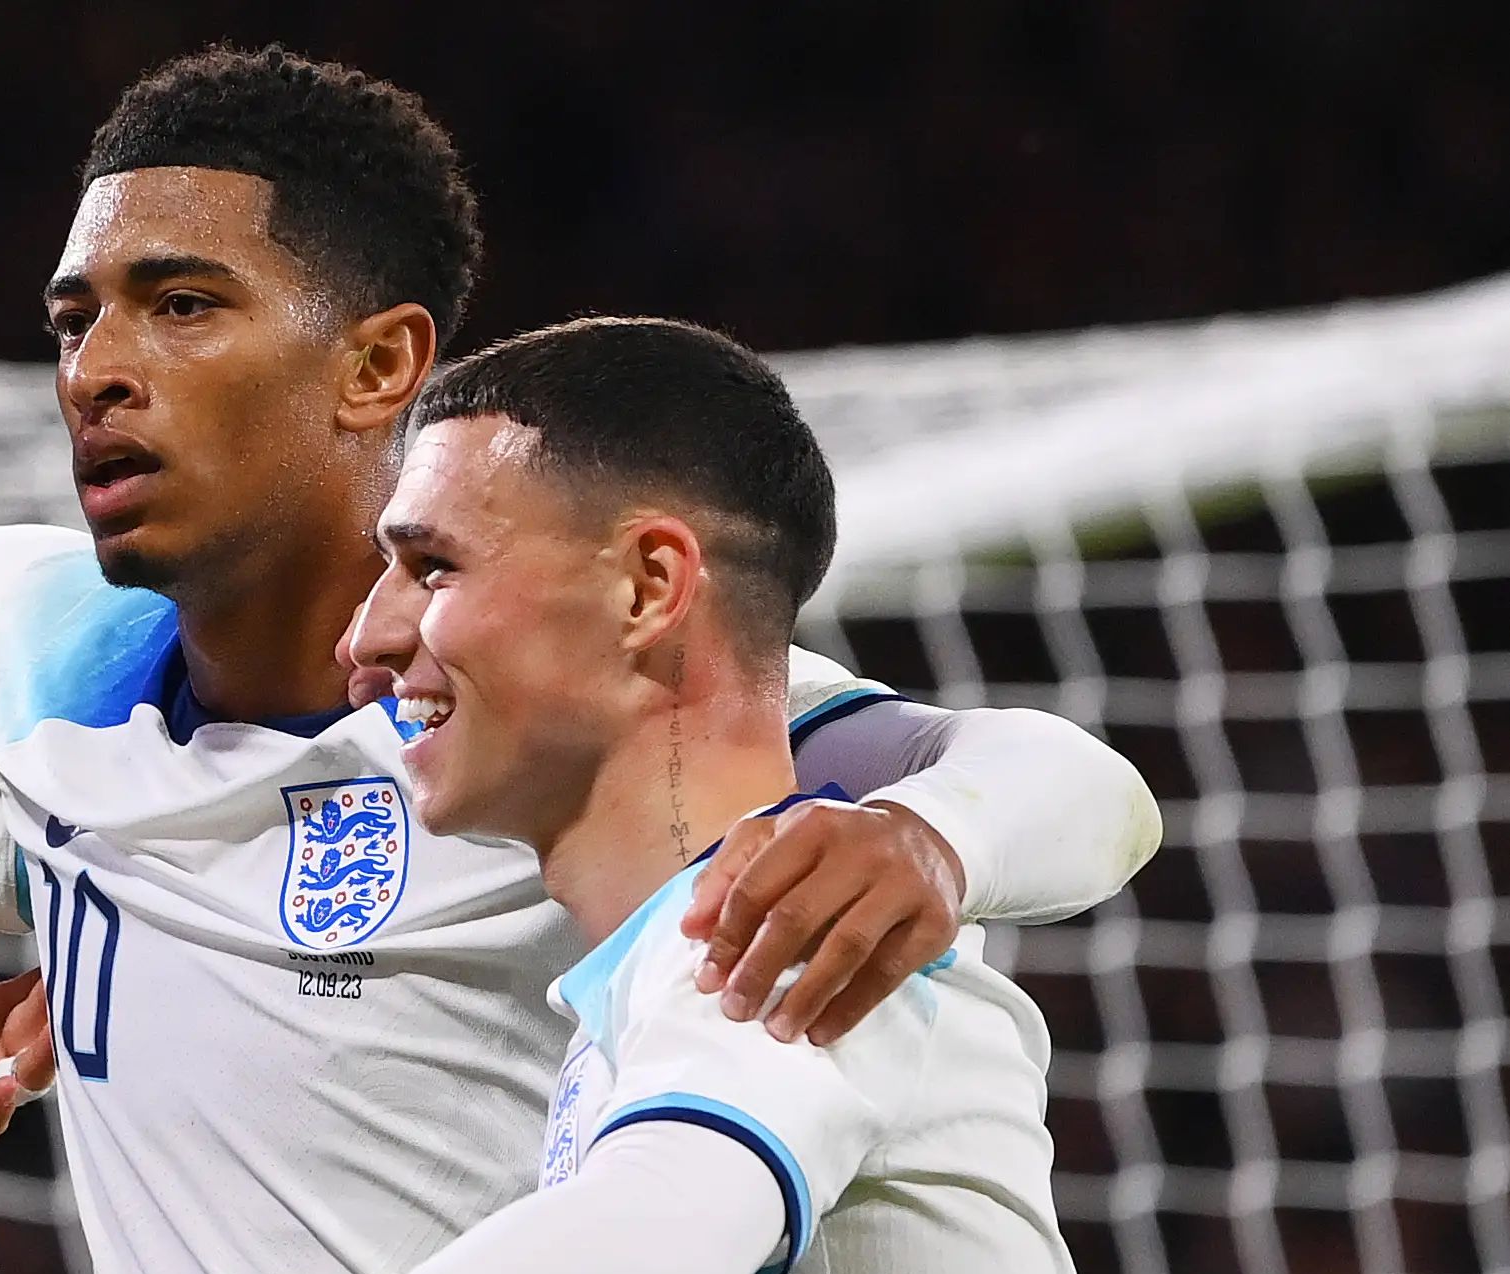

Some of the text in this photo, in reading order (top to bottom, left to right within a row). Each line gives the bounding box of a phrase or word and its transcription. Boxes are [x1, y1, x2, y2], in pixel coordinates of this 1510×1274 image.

[670, 794, 691, 863] LIMIT
[39, 858, 121, 1082] 10
[298, 969, 363, 1000] 12.09.23
